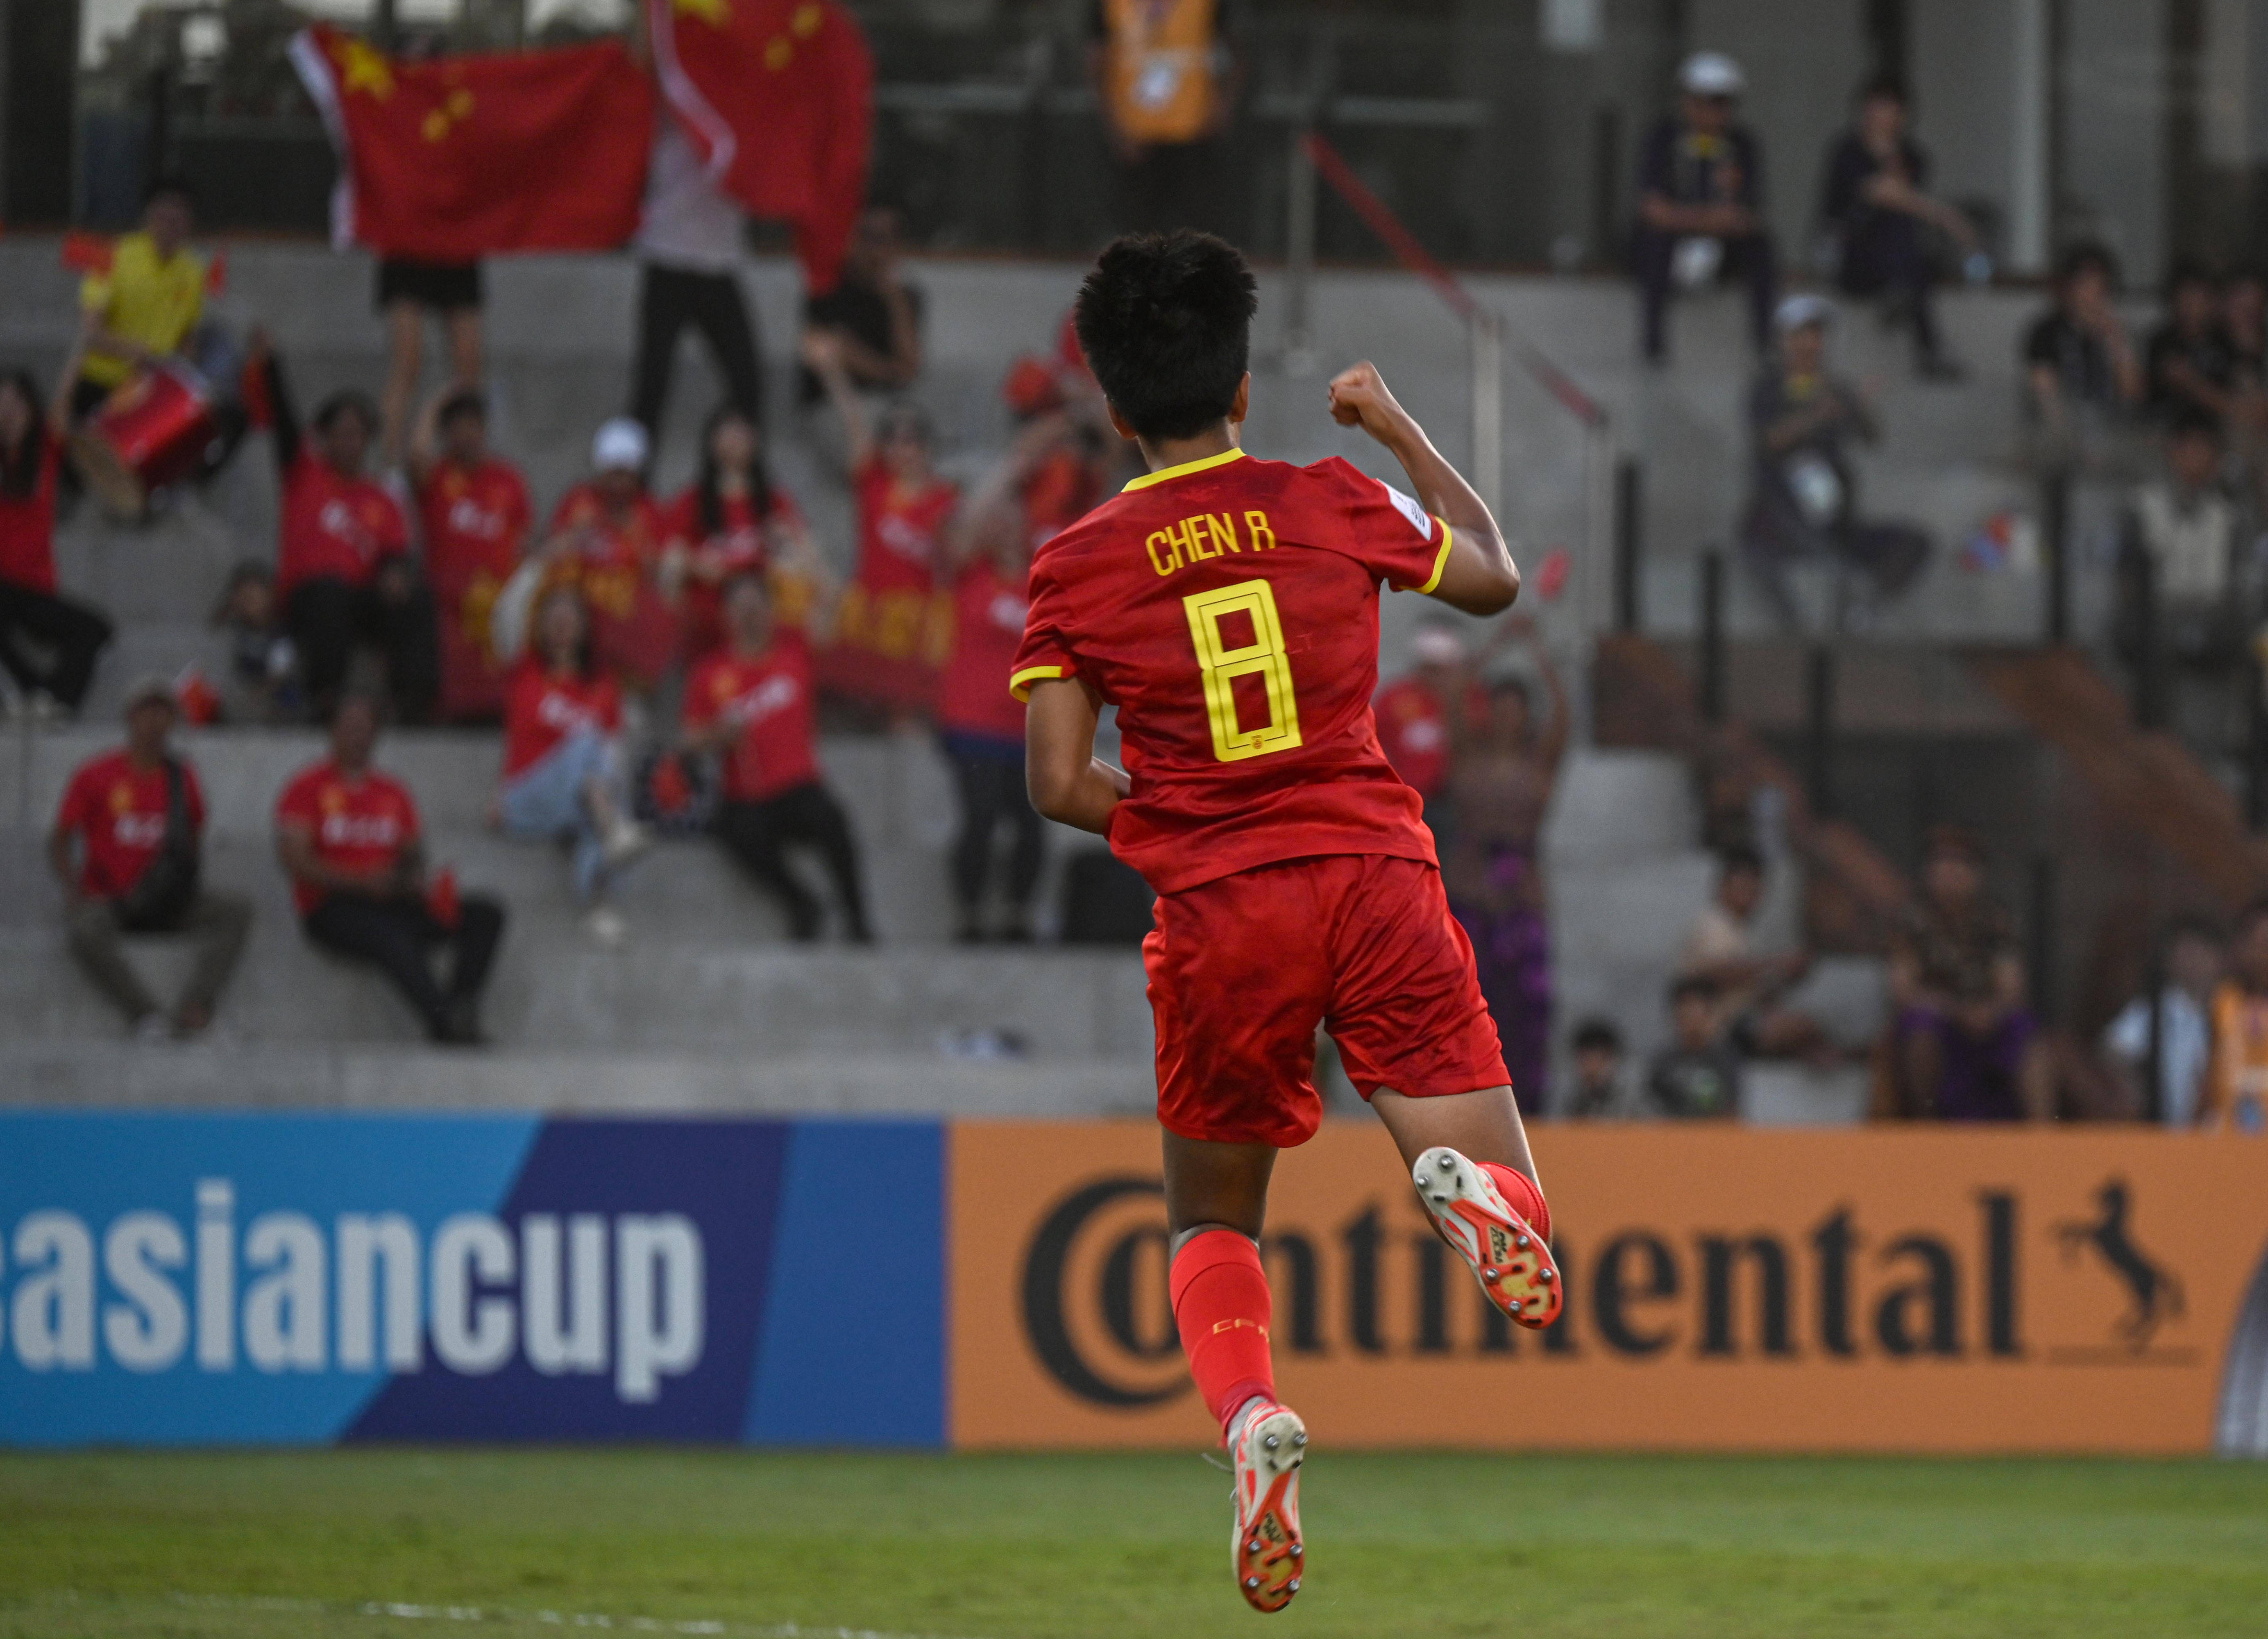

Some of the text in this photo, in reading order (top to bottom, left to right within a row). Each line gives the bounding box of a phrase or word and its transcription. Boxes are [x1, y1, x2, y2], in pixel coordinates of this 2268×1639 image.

[1145, 511, 1276, 576] CHEN R
[1182, 579, 1303, 762] 8
[0, 1181, 705, 1403] asiancup
